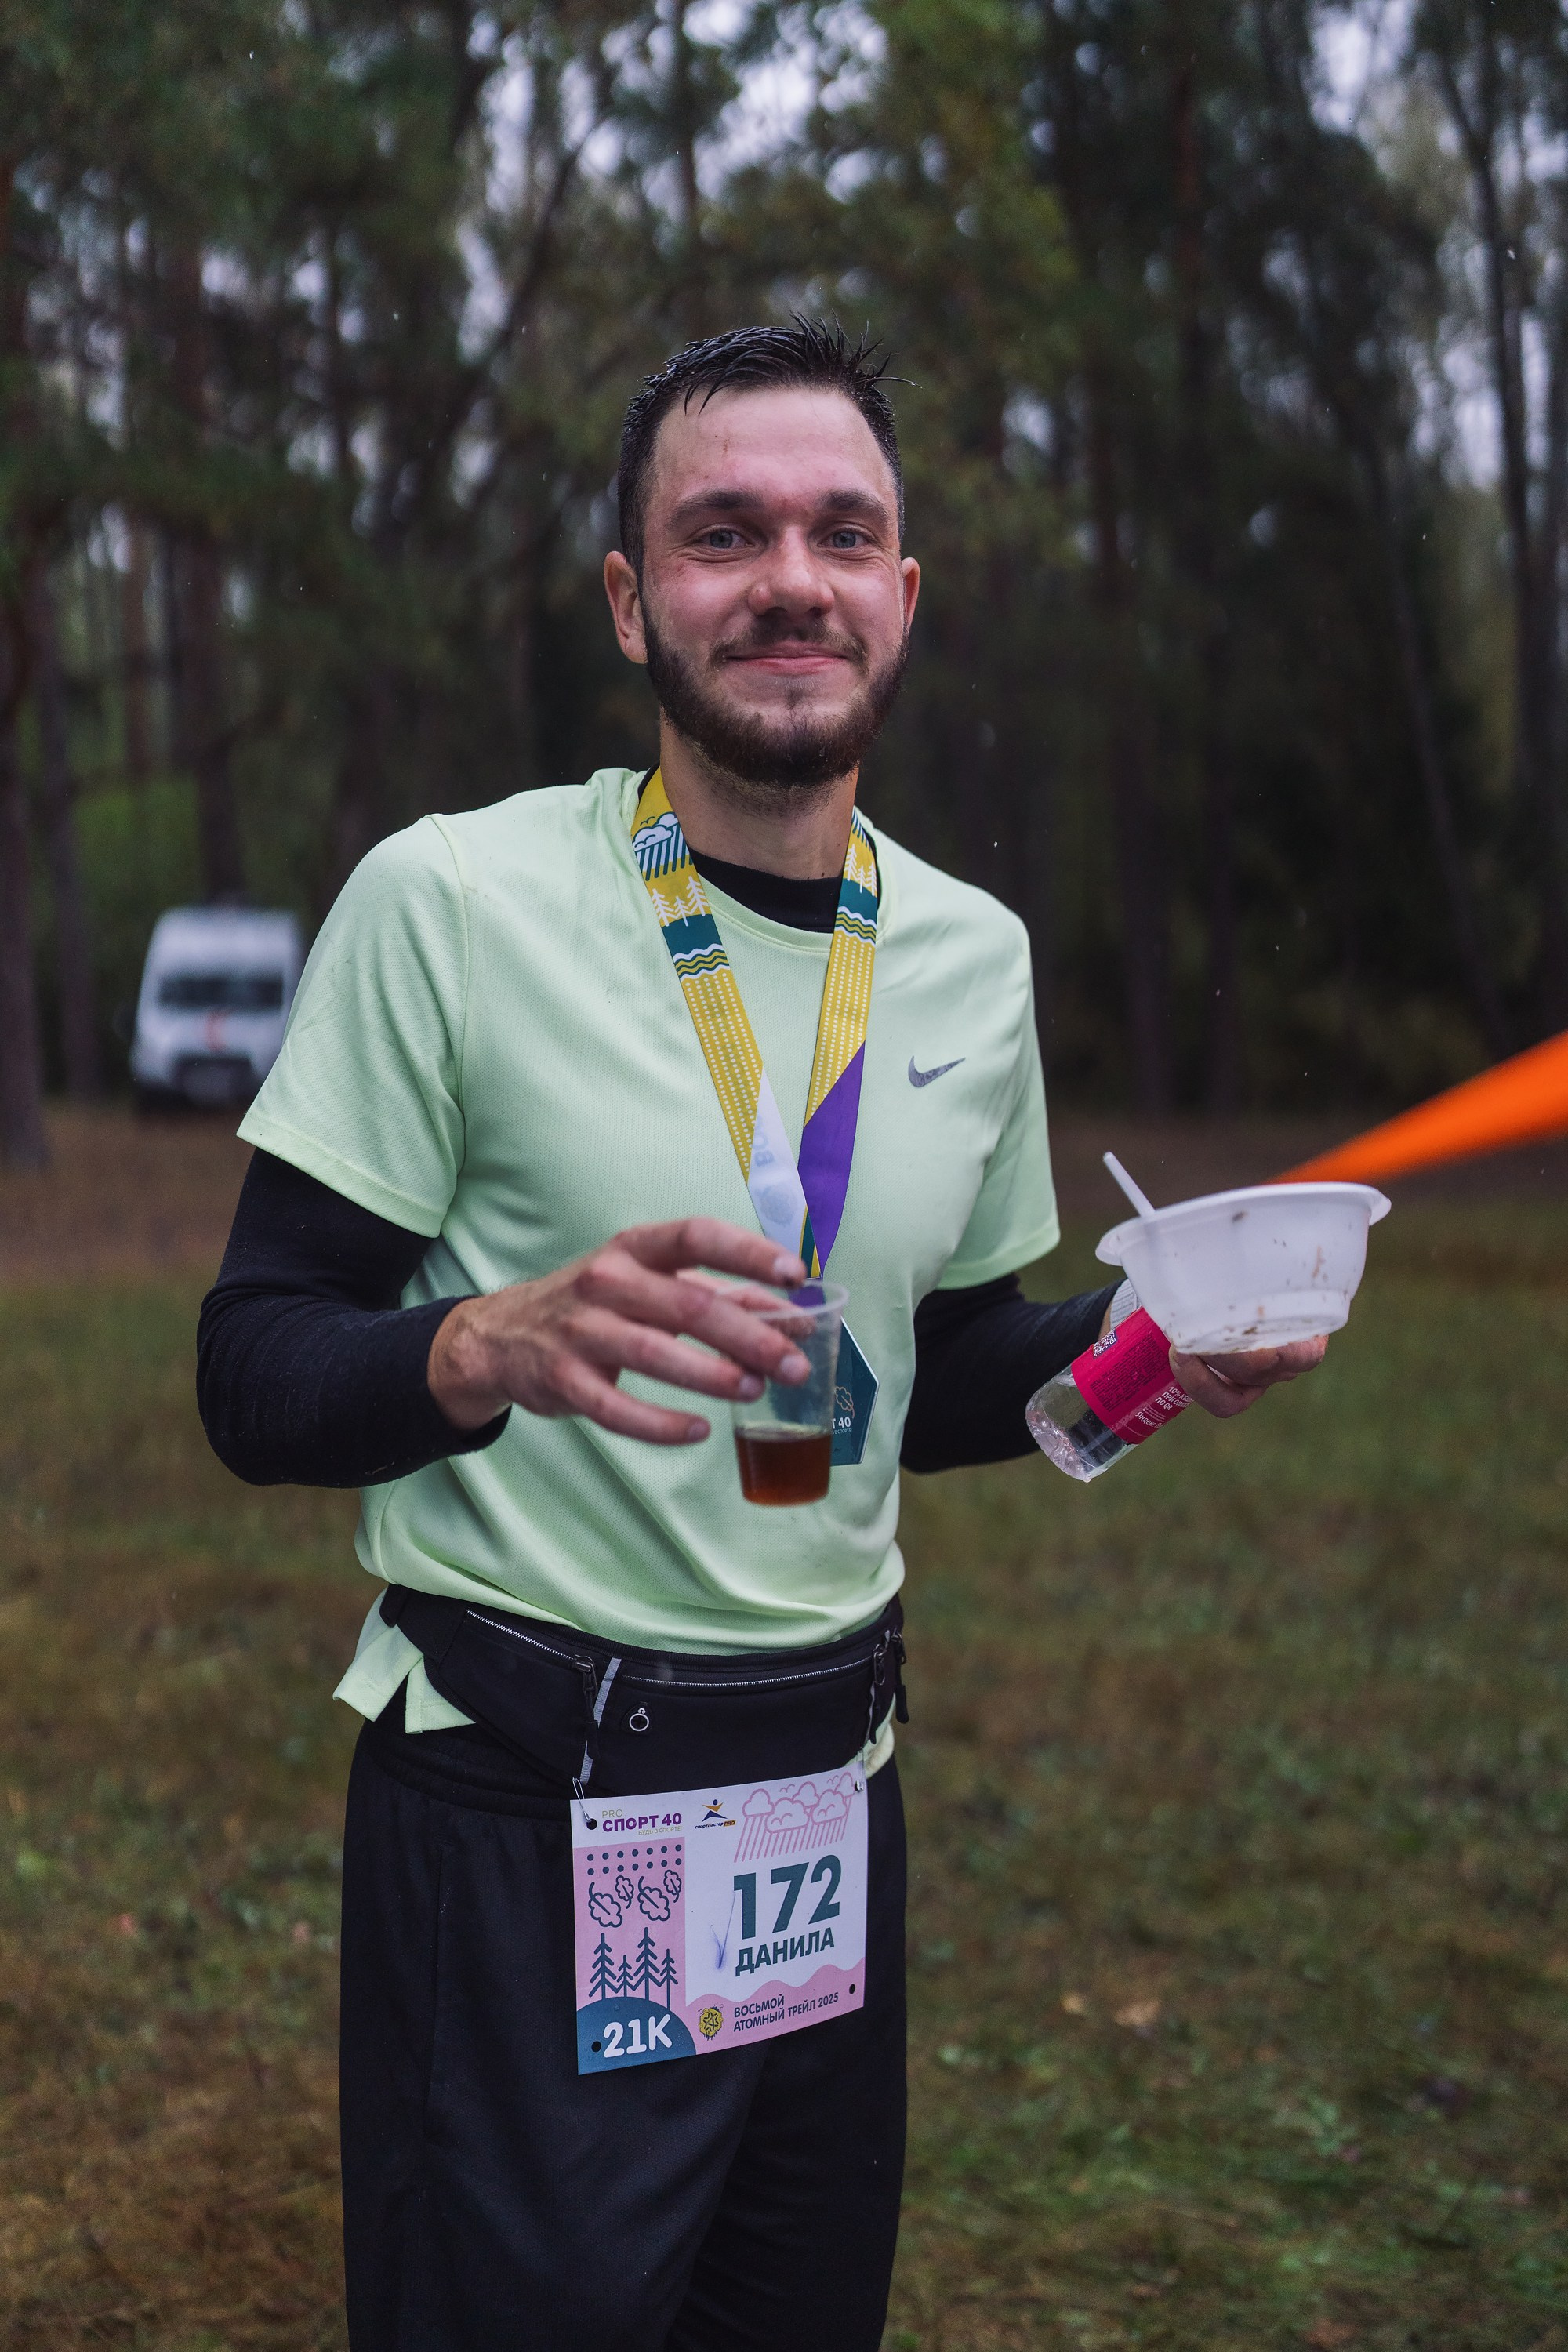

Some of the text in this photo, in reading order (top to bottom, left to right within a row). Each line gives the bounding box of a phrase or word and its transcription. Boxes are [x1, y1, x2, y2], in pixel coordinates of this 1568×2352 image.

[1155, 1396, 1165, 1406] ПО
[1162, 1392, 1175, 1403] ПРИ
[838, 1417, 851, 1428] 40
[1135, 1411, 1156, 1428] Яндекс
[602, 1809, 623, 1818] PRO
[602, 1813, 682, 1832] СПОРТ 40
[733, 1854, 842, 1940] 172
[735, 1927, 834, 1976] ДАНИЛА
[733, 1992, 839, 2032] АТОМНЫЙ ТРЕЙЛ 2025
[734, 1993, 784, 2018] ВОСЬМОЙ
